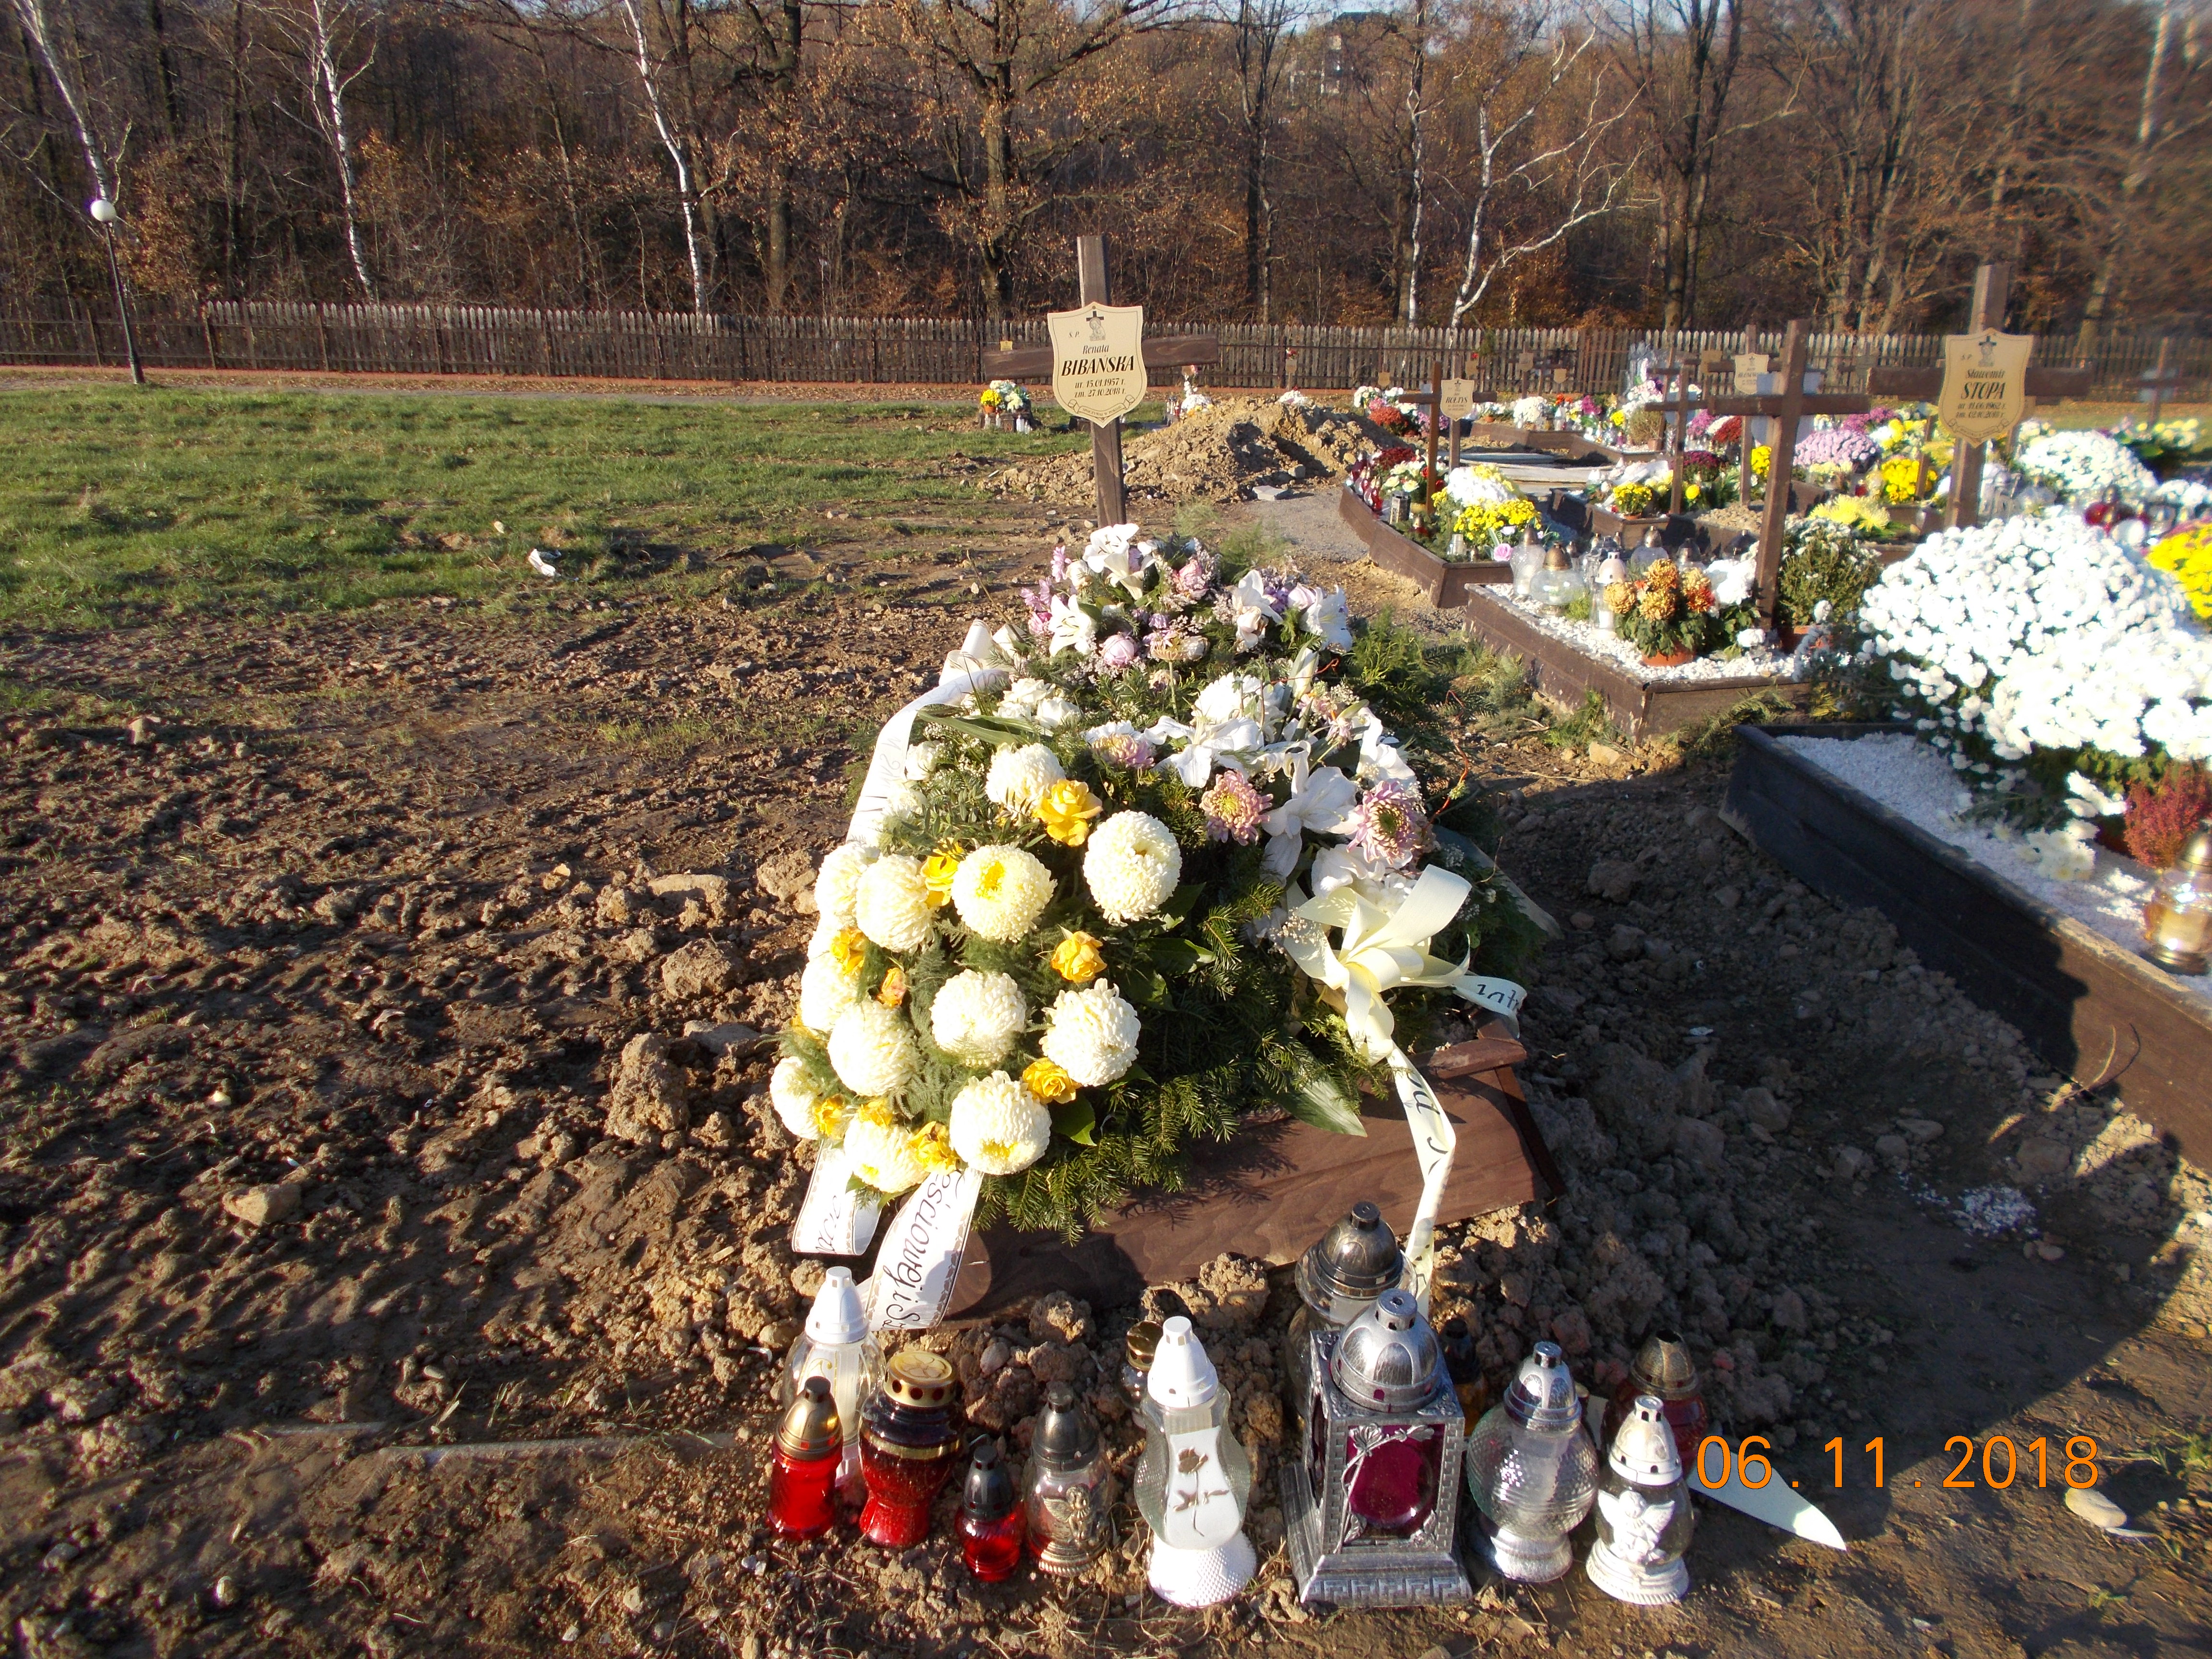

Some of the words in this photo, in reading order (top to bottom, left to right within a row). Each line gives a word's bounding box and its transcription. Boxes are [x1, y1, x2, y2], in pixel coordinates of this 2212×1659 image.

[1082, 345, 1109, 354] Renata
[1061, 355, 1134, 376] BIBAŃSKA
[1086, 378, 1119, 387] 15.01.1957
[1088, 388, 1120, 397] 27.10.2018
[1961, 382, 2006, 399] STOPA
